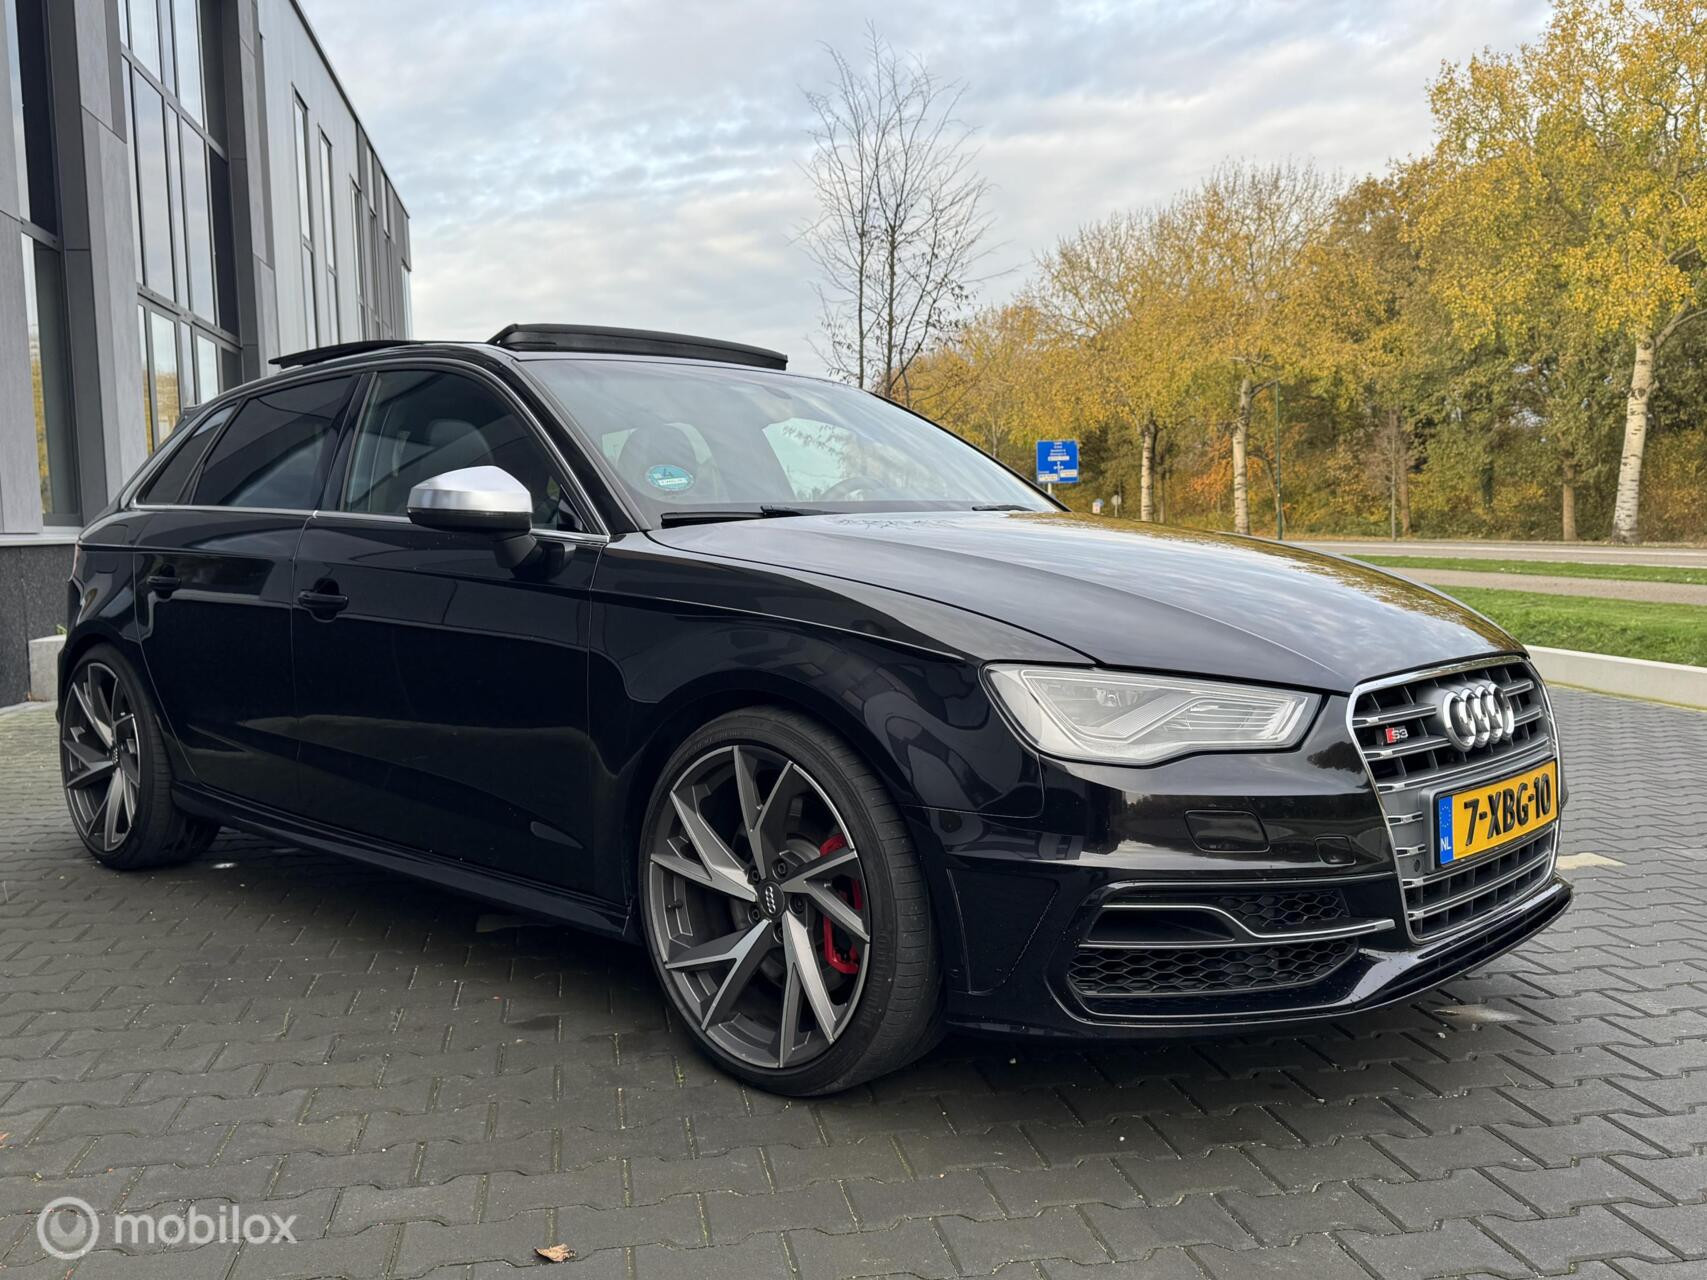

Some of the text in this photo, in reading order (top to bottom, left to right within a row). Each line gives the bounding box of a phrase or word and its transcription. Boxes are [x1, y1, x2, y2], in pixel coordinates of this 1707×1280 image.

[1391, 728, 1409, 740] S3
[1463, 773, 1551, 847] 7-XBG-10
[1440, 836, 1452, 851] NL
